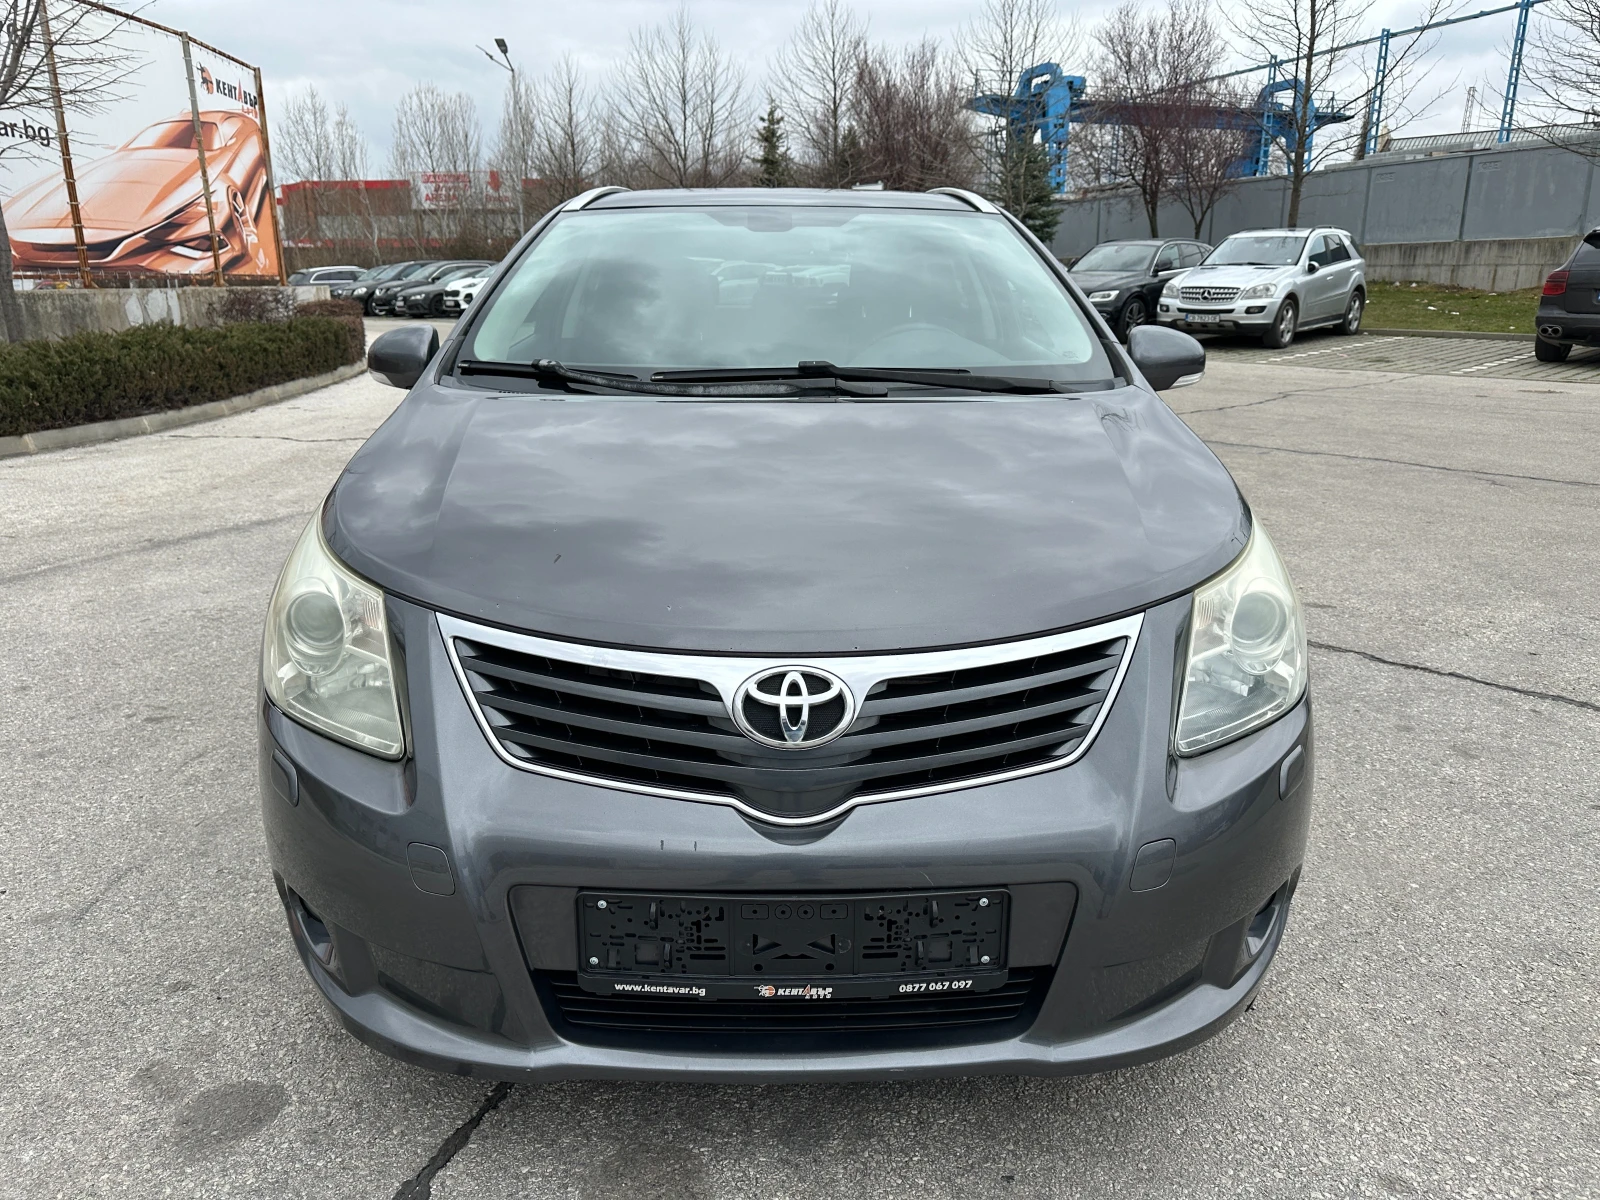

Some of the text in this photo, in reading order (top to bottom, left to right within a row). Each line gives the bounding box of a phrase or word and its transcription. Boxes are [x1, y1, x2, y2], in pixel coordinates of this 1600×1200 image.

[215, 78, 258, 110] КЕНТАВЪР
[0, 119, 50, 147] ar.bg
[614, 983, 706, 996] www.kentavar.bg
[777, 984, 833, 996] КЕНТАВЪР
[899, 980, 973, 993] 0877 067 097
